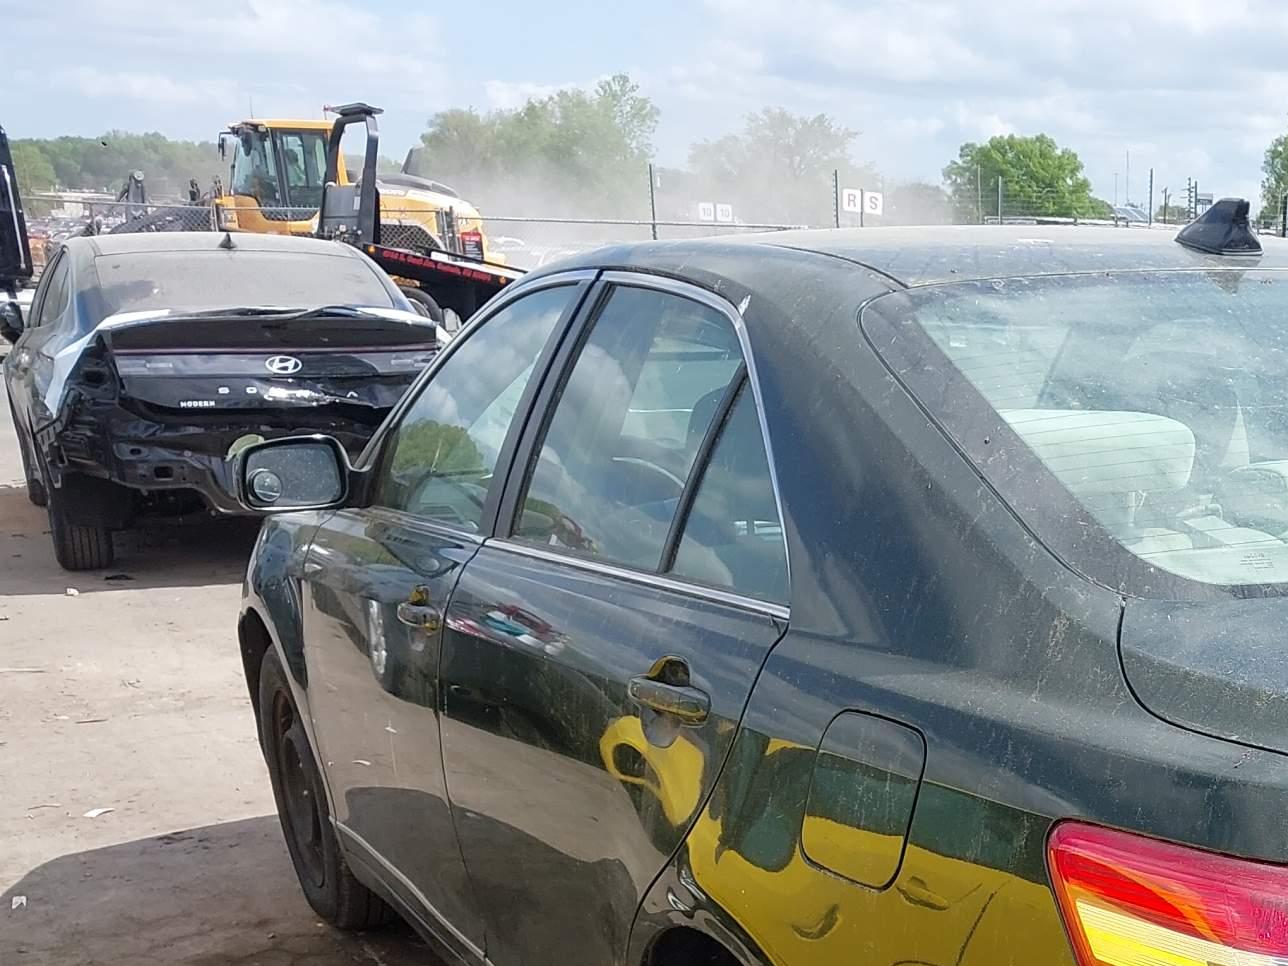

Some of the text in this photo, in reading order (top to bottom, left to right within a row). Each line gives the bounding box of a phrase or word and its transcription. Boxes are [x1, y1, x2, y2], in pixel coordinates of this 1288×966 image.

[847, 193, 857, 207] R
[869, 196, 878, 210] S
[702, 207, 712, 217] 10
[720, 207, 730, 218] 10
[179, 400, 216, 408] MODERN
